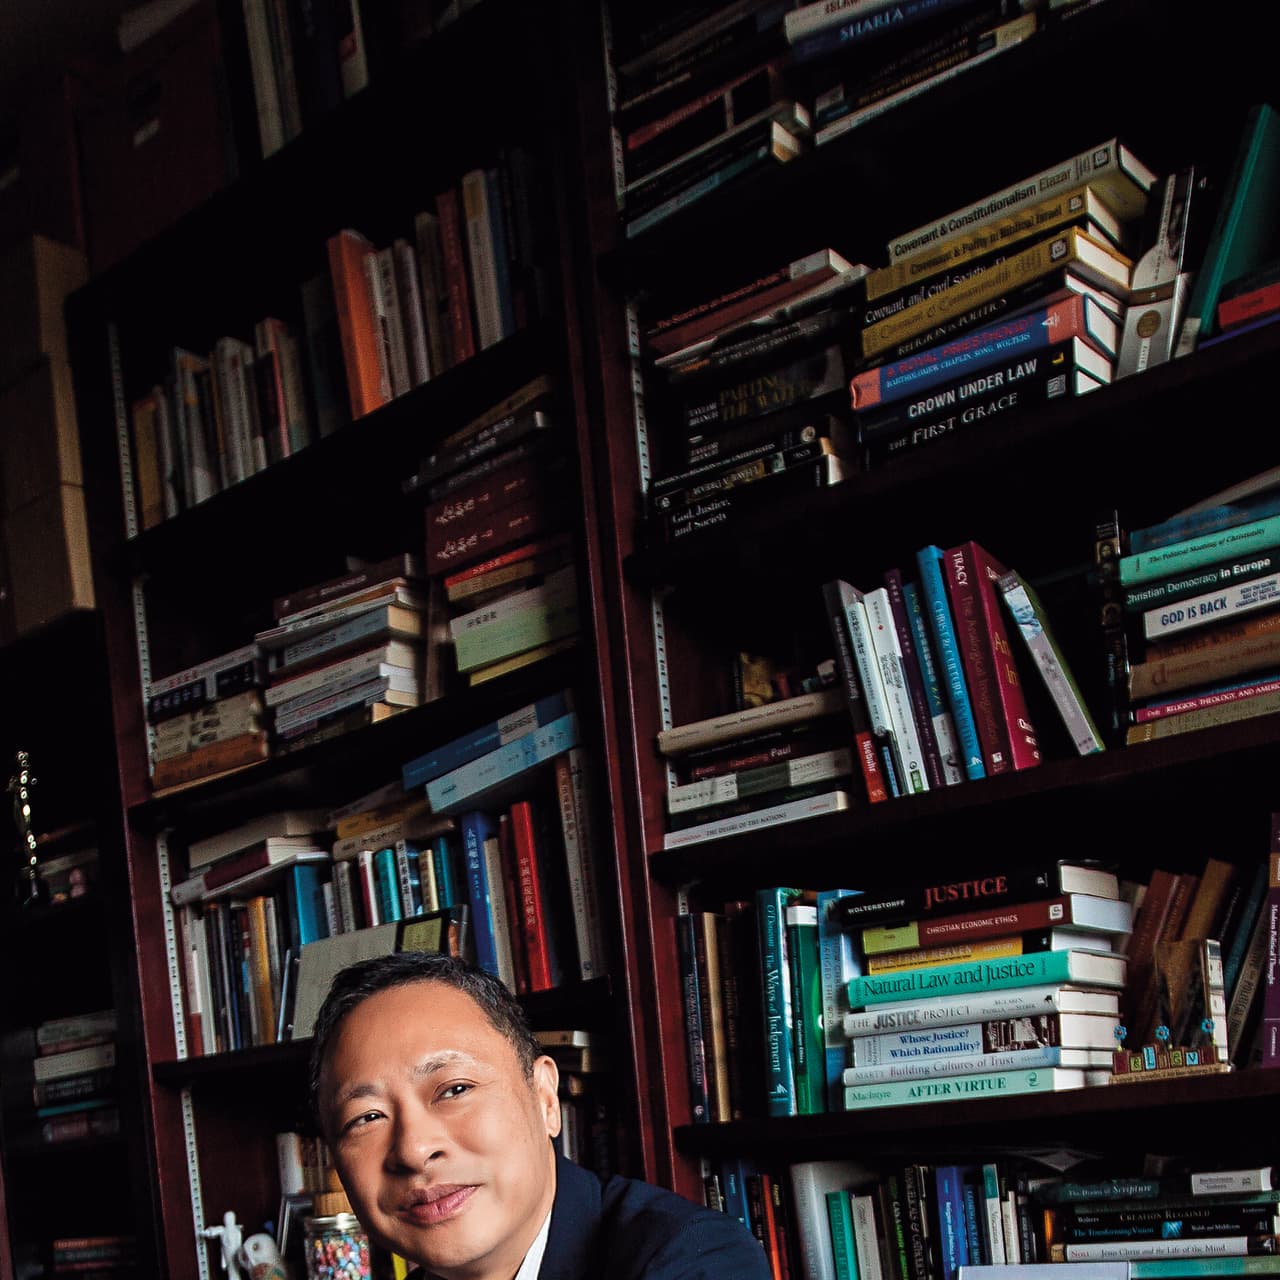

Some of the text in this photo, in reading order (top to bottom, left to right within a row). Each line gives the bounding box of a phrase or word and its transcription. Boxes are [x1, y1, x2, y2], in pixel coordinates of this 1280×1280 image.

[895, 169, 1072, 256] Covenant & Constitutionalism Elazar
[908, 358, 1037, 418] CROWN UNDER LAW
[912, 417, 955, 444] FIRST
[960, 393, 1017, 423] GRACE
[952, 551, 968, 585] TRACY
[1168, 571, 1218, 595] Democracy
[1220, 568, 1230, 580] in
[1233, 558, 1271, 576] Europe
[1161, 597, 1227, 625] GOD IS BACK
[848, 875, 1008, 914] WOLTERSTORFF JUSTICE
[926, 914, 1018, 935] CHRISTIAN ECONOMIC ETHICS
[767, 970, 779, 1002] Ways
[864, 960, 1035, 997] Natural Law and Justice
[852, 1007, 970, 1029] THE JUSTICE PROJECT
[769, 1016, 782, 1072] Judgment
[890, 1041, 980, 1058] Which Rationality?
[900, 1029, 969, 1044] Whose Justice?
[908, 1083, 951, 1097] AFTER
[956, 1077, 1006, 1092] VIRTUE
